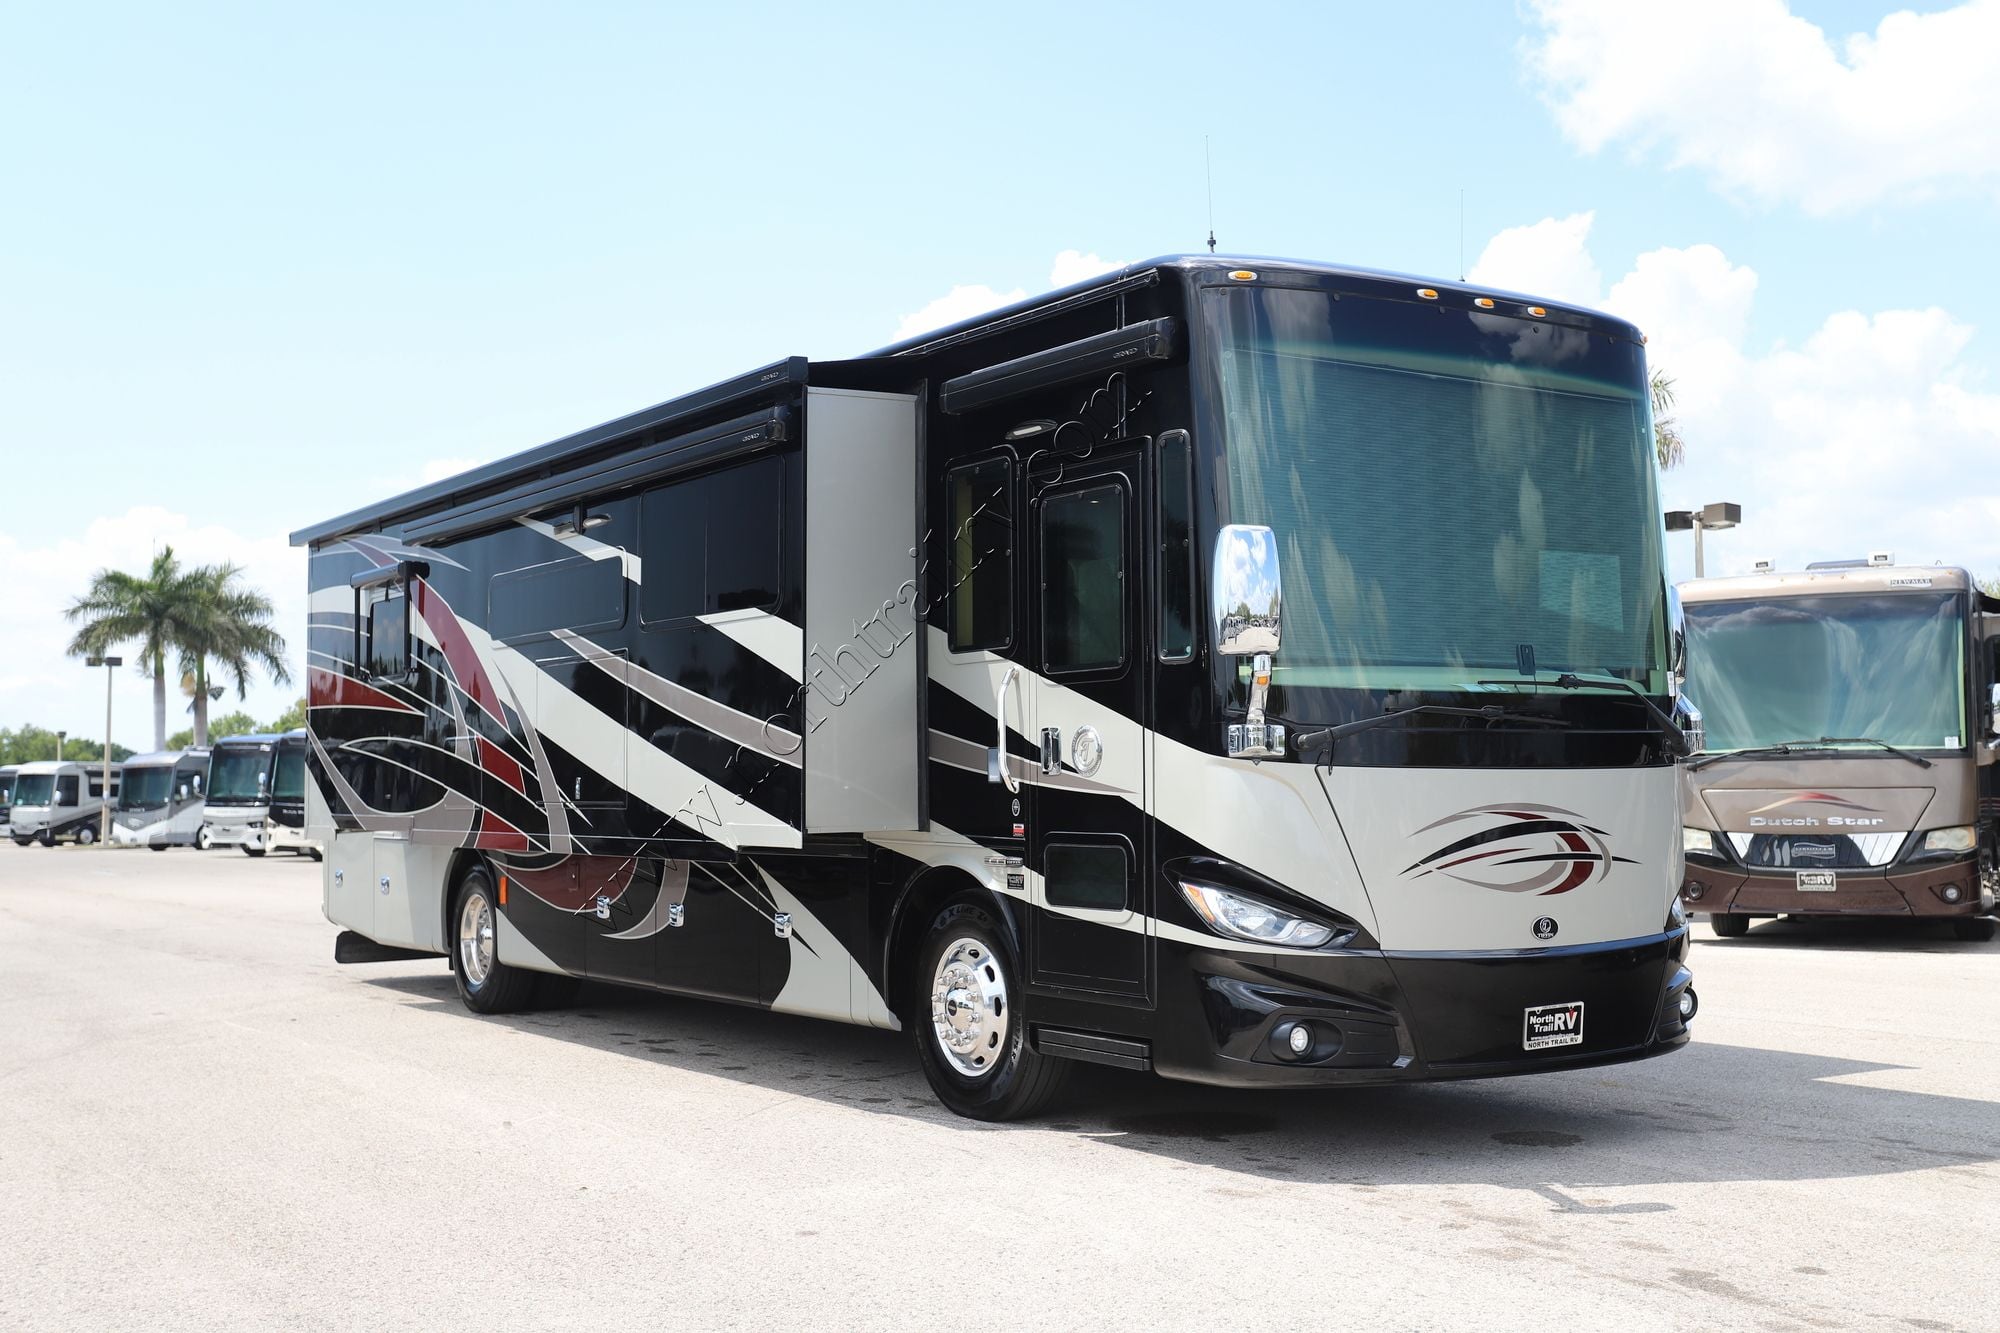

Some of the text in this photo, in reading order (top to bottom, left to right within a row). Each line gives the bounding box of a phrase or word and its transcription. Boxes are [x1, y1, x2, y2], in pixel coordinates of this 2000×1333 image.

[1750, 816, 1884, 826] Dutch Star
[1817, 875, 1833, 885] RV
[1530, 1014, 1554, 1024] North
[1554, 1011, 1578, 1031] RV
[1533, 1023, 1554, 1032] Trail
[1528, 1040, 1549, 1048] NORTH
